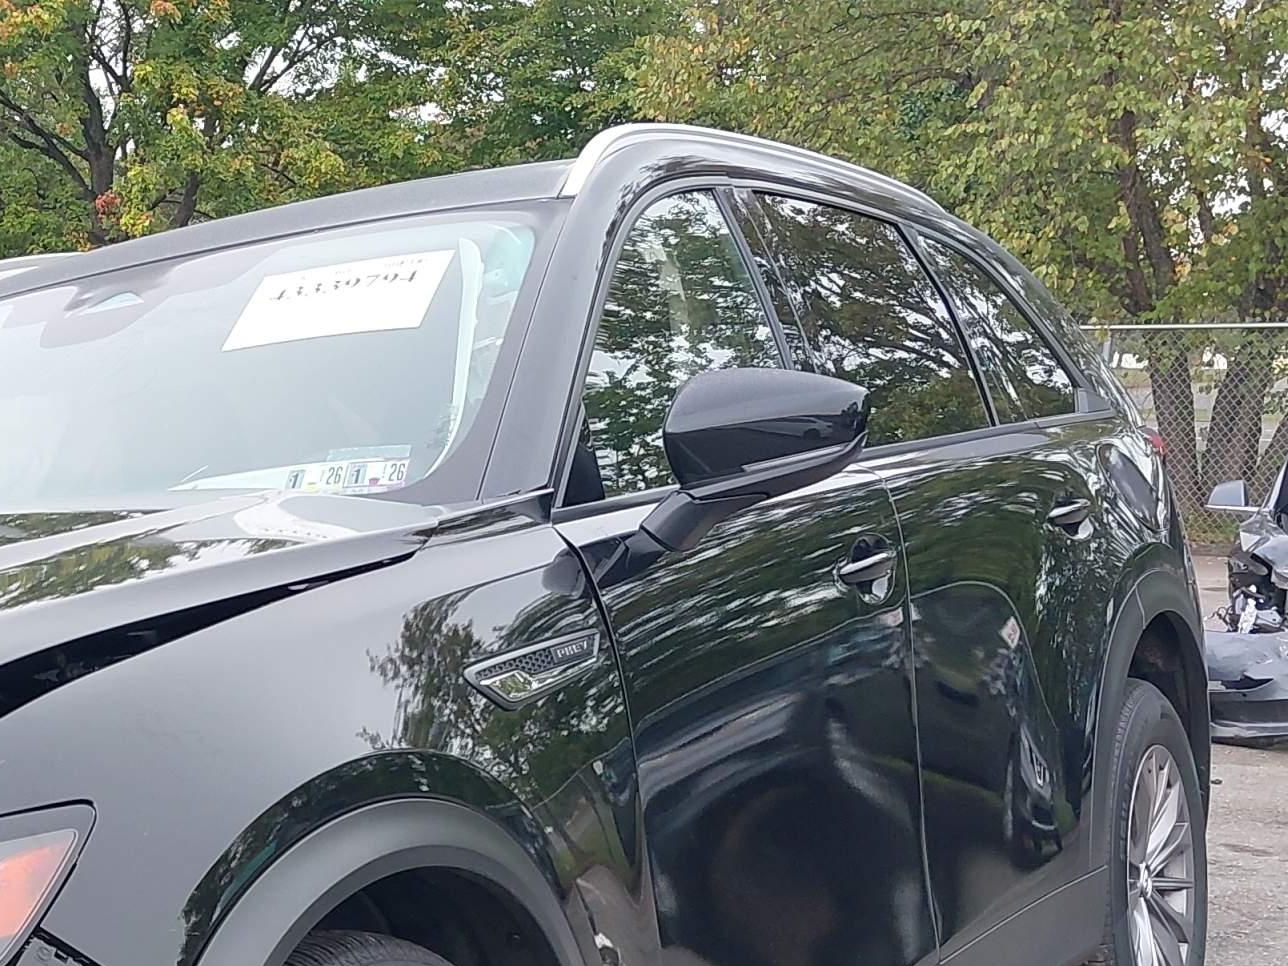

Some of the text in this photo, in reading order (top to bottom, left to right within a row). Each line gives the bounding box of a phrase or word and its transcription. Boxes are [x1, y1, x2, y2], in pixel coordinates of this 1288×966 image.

[326, 466, 343, 485] 26
[389, 463, 405, 481] 26
[557, 640, 587, 658] PHEV
